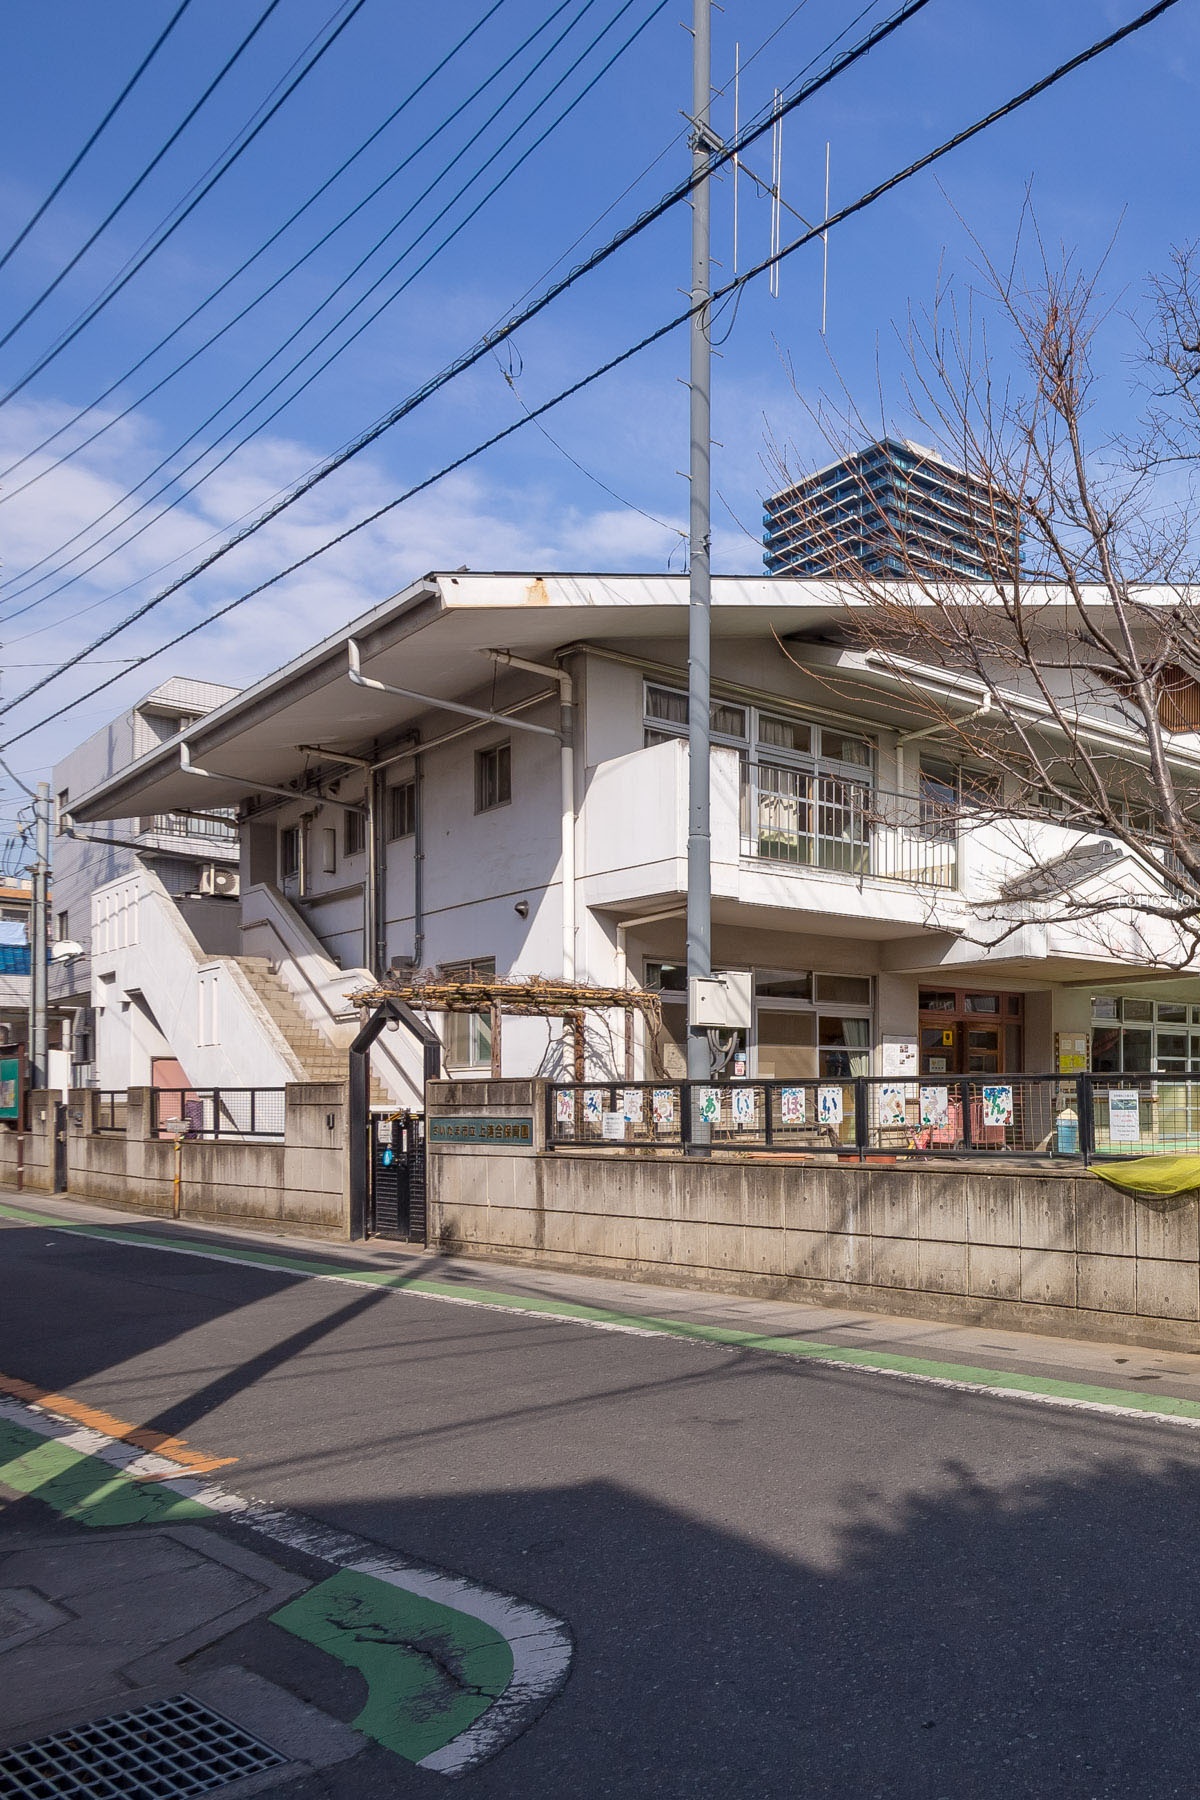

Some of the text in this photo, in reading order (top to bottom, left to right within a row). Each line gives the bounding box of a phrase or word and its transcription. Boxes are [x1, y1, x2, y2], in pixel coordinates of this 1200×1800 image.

[705, 1096, 716, 1115] あ
[478, 1123, 530, 1139] 上落合保育園
